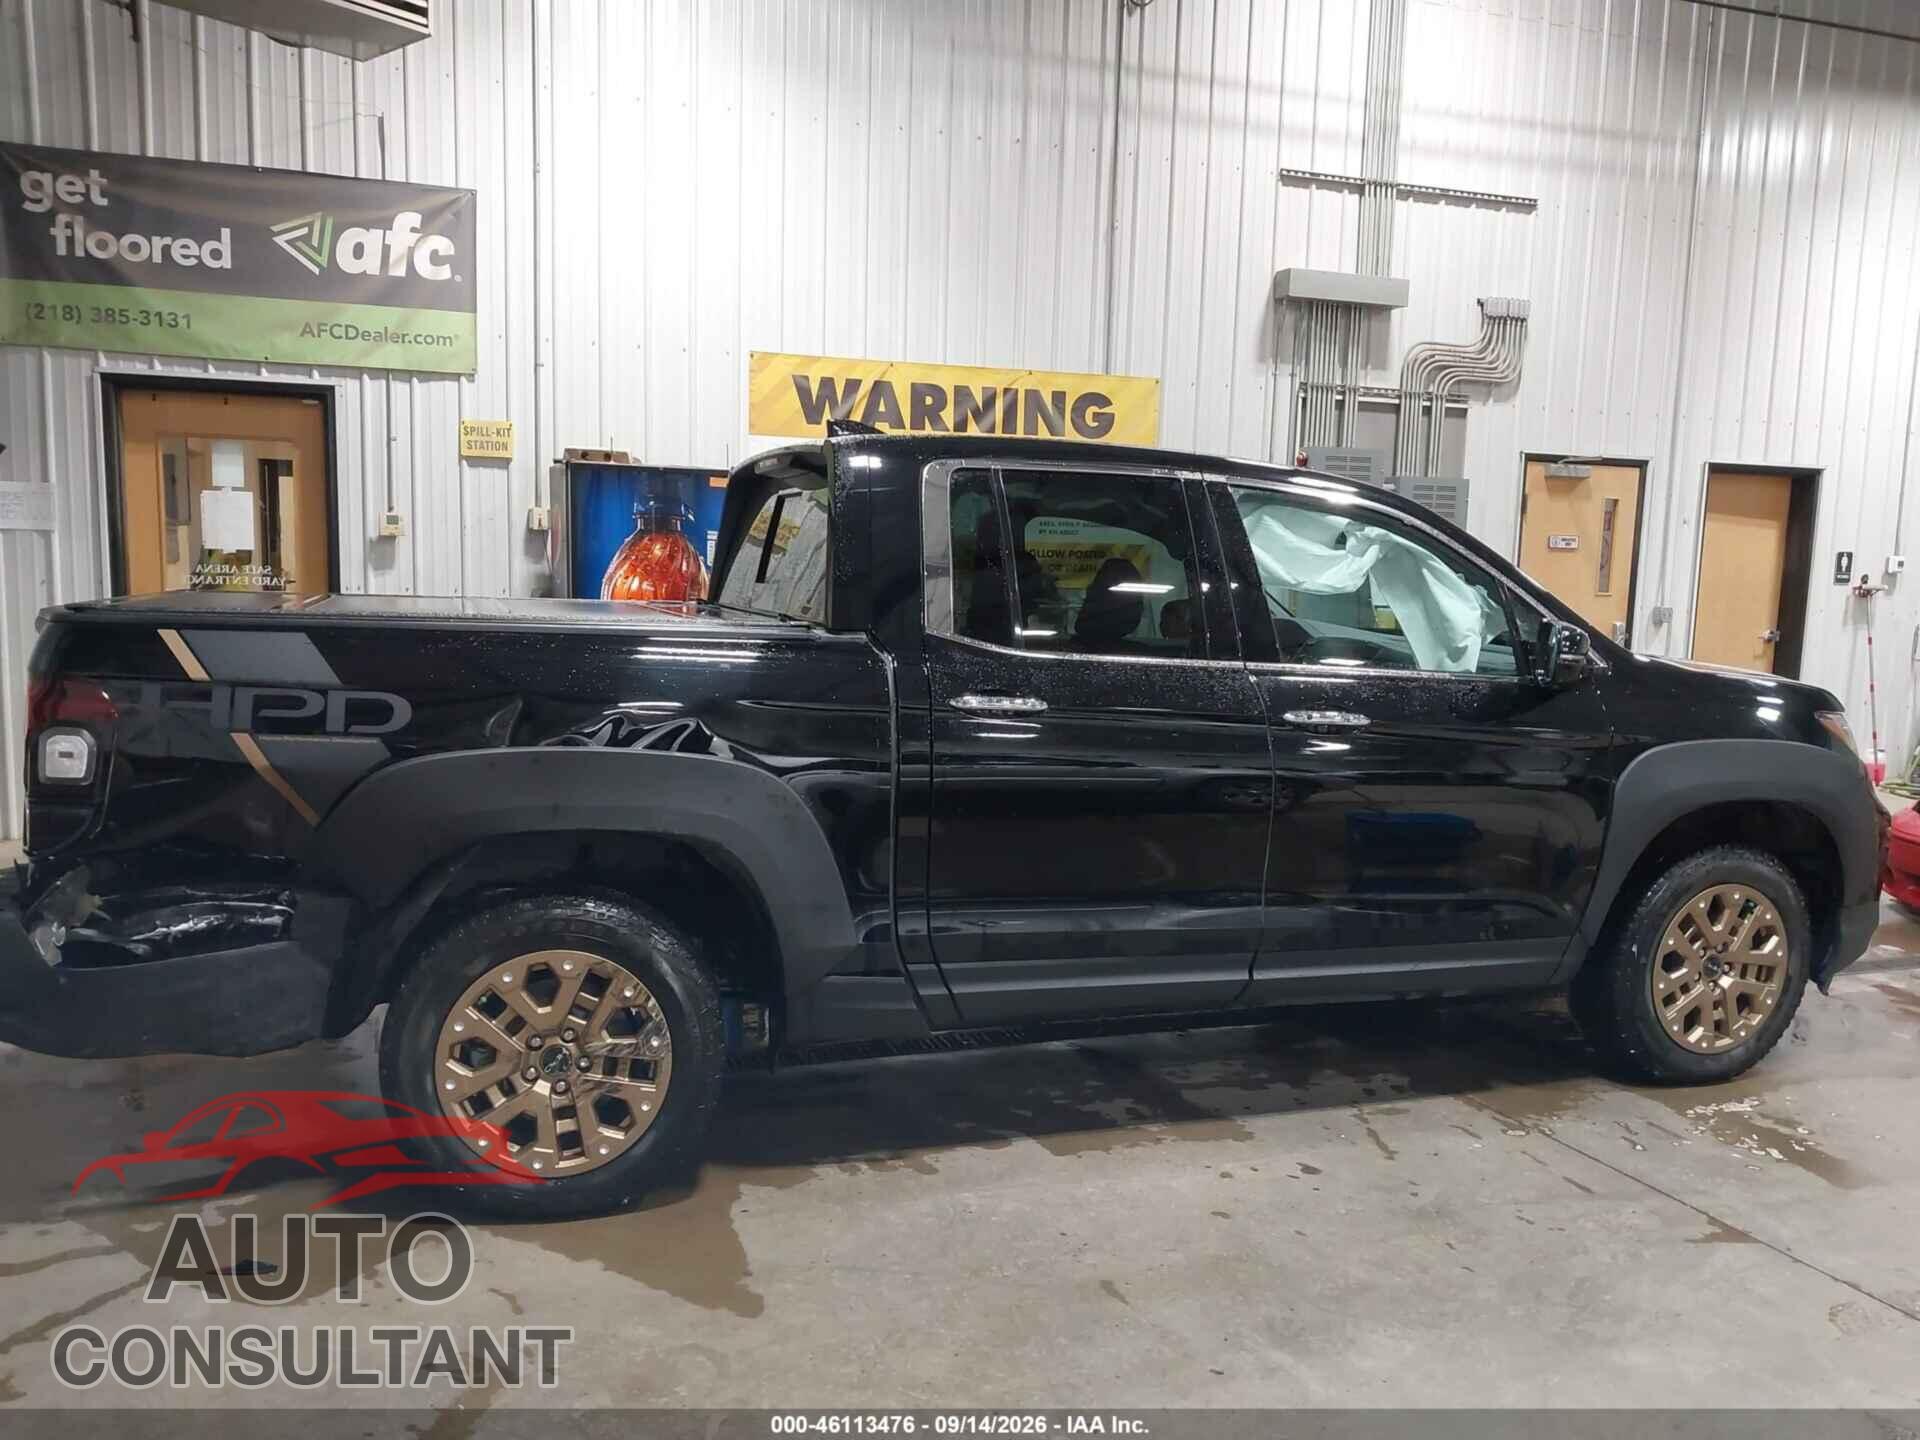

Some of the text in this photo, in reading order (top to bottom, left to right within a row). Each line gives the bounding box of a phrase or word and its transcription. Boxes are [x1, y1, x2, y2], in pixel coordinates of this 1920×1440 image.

[19, 168, 108, 213] get
[50, 213, 232, 270] floored
[25, 302, 192, 331] (218) 385-3131
[300, 321, 454, 347] AFCDealer.com
[791, 374, 1116, 440] WARNING
[463, 425, 511, 438] SPILL-KIT
[466, 439, 508, 451] STATION
[125, 682, 413, 734] HPD
